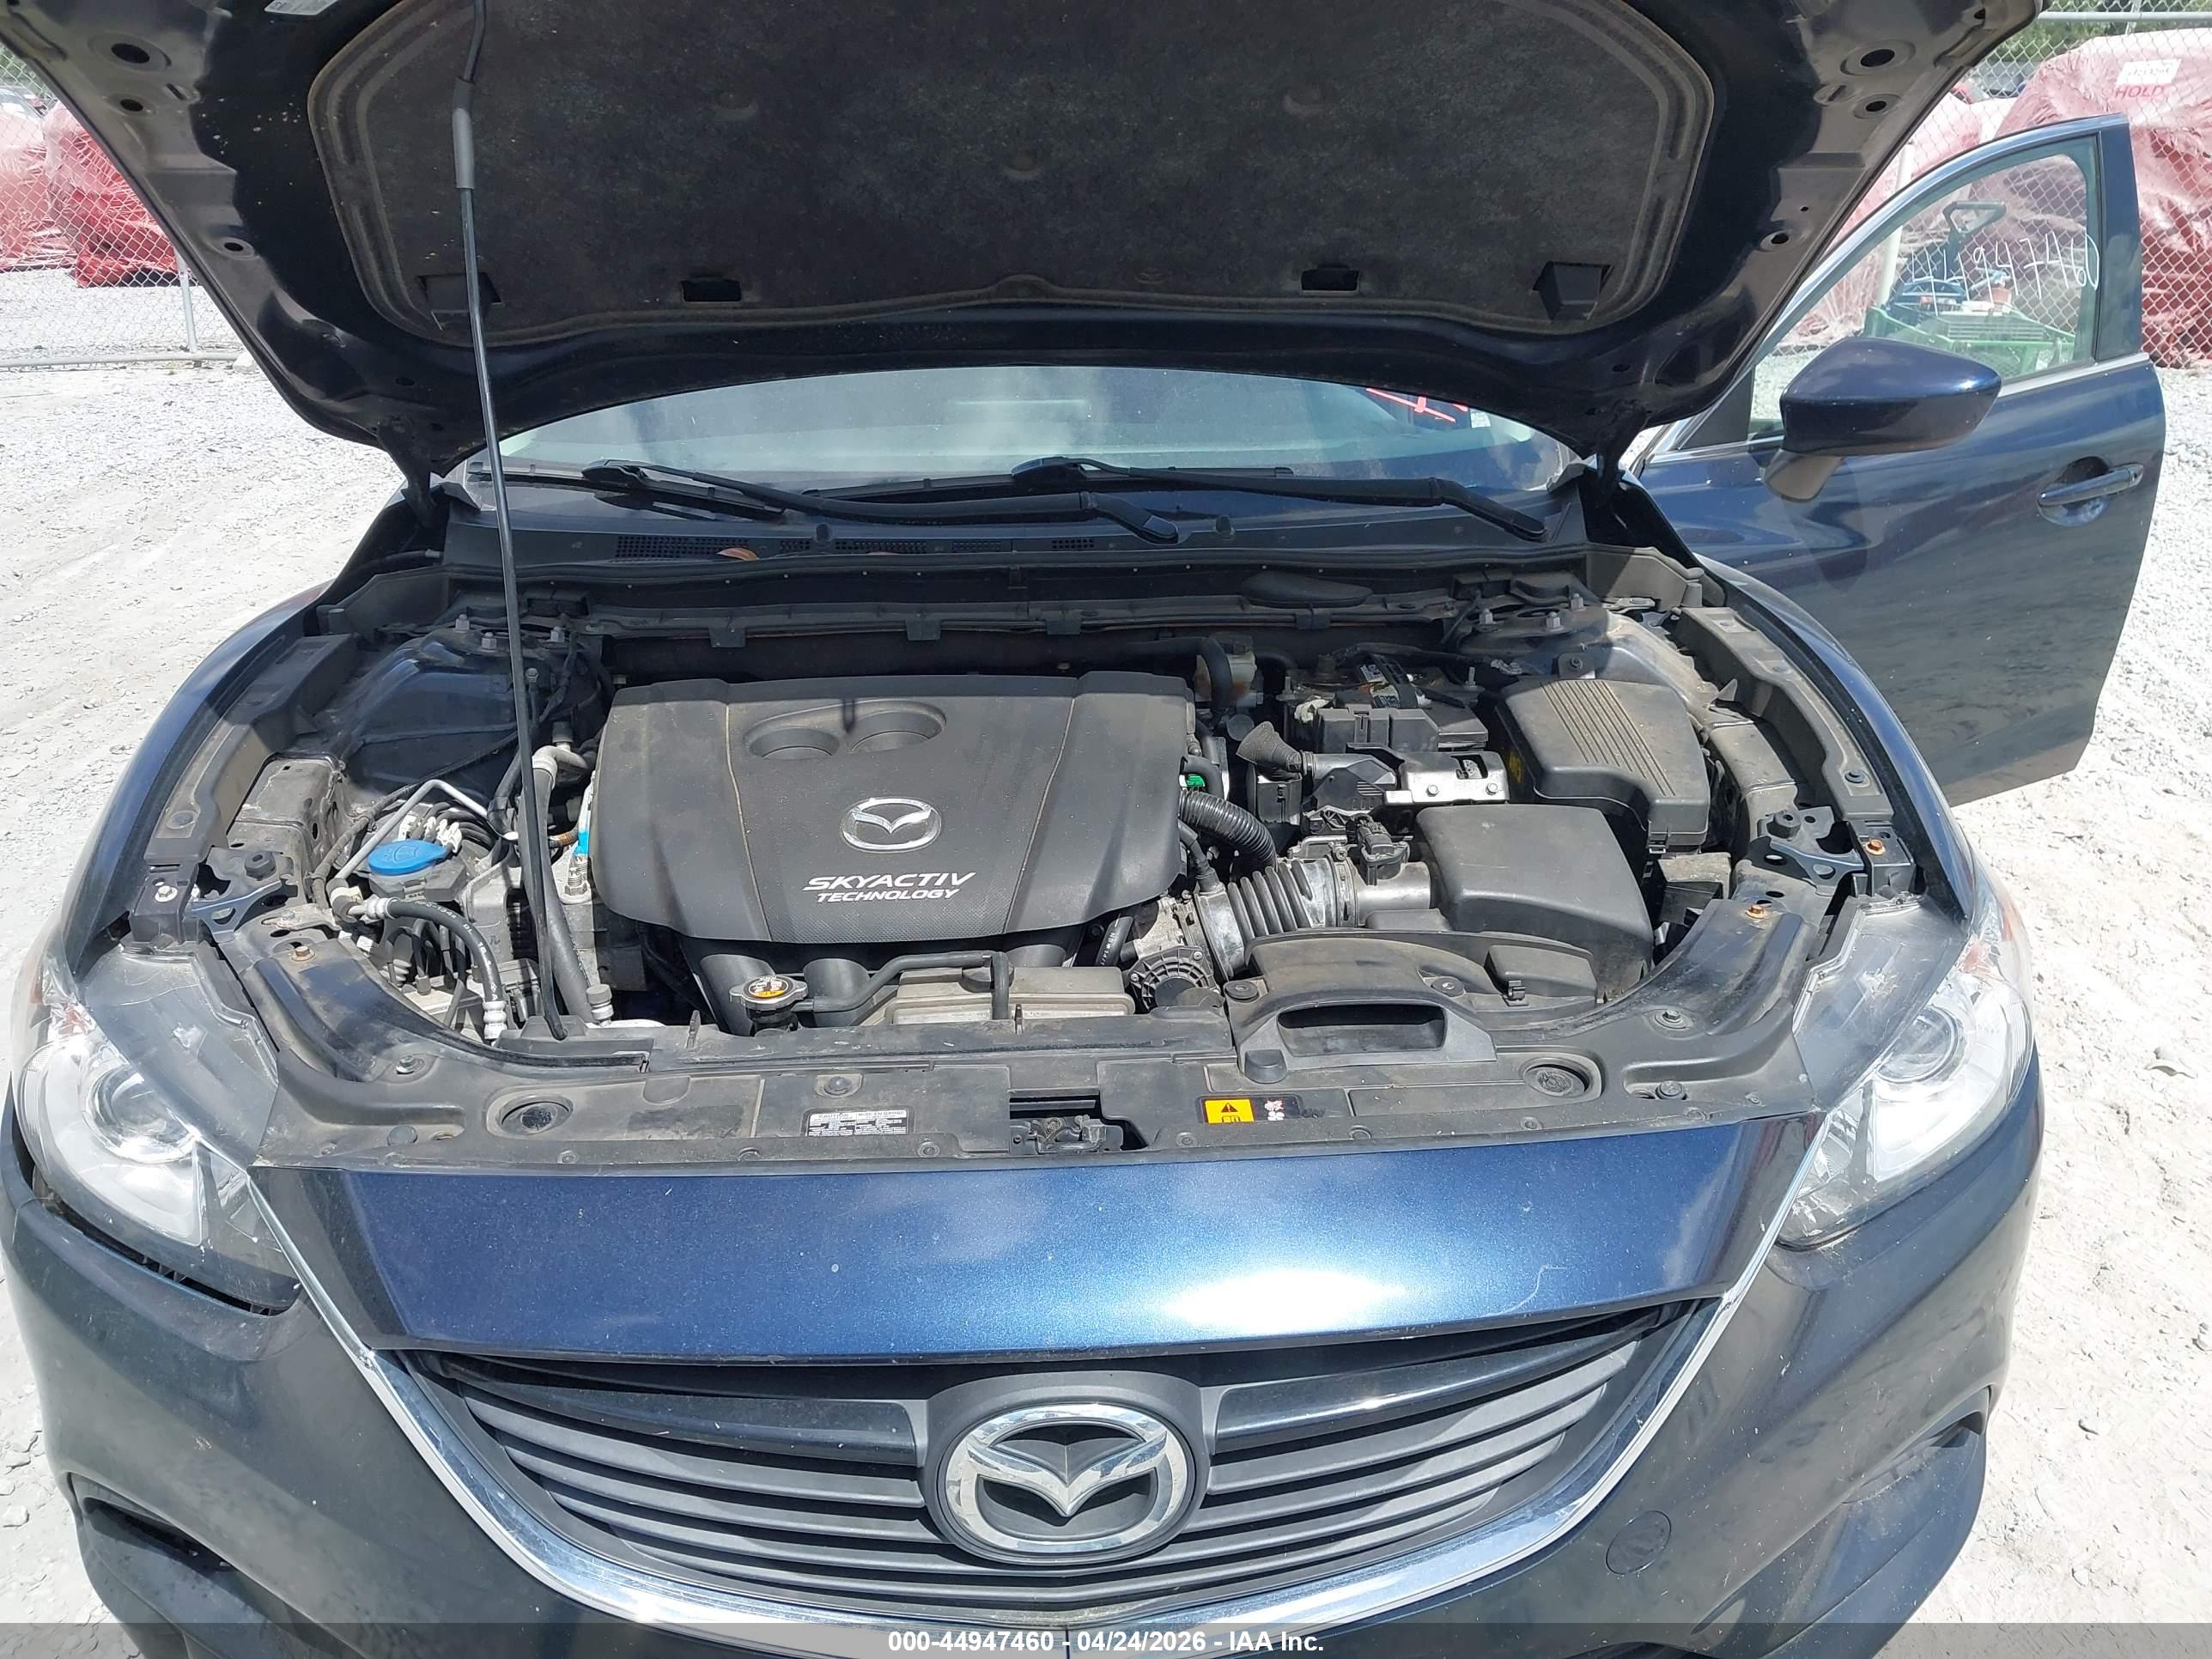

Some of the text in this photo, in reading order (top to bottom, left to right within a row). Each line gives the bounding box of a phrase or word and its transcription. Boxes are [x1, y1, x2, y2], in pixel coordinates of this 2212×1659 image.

[1911, 230, 2100, 317] 44947460
[802, 872, 976, 891] SKYACTIV
[817, 888, 961, 902] TECHNOLOGY
